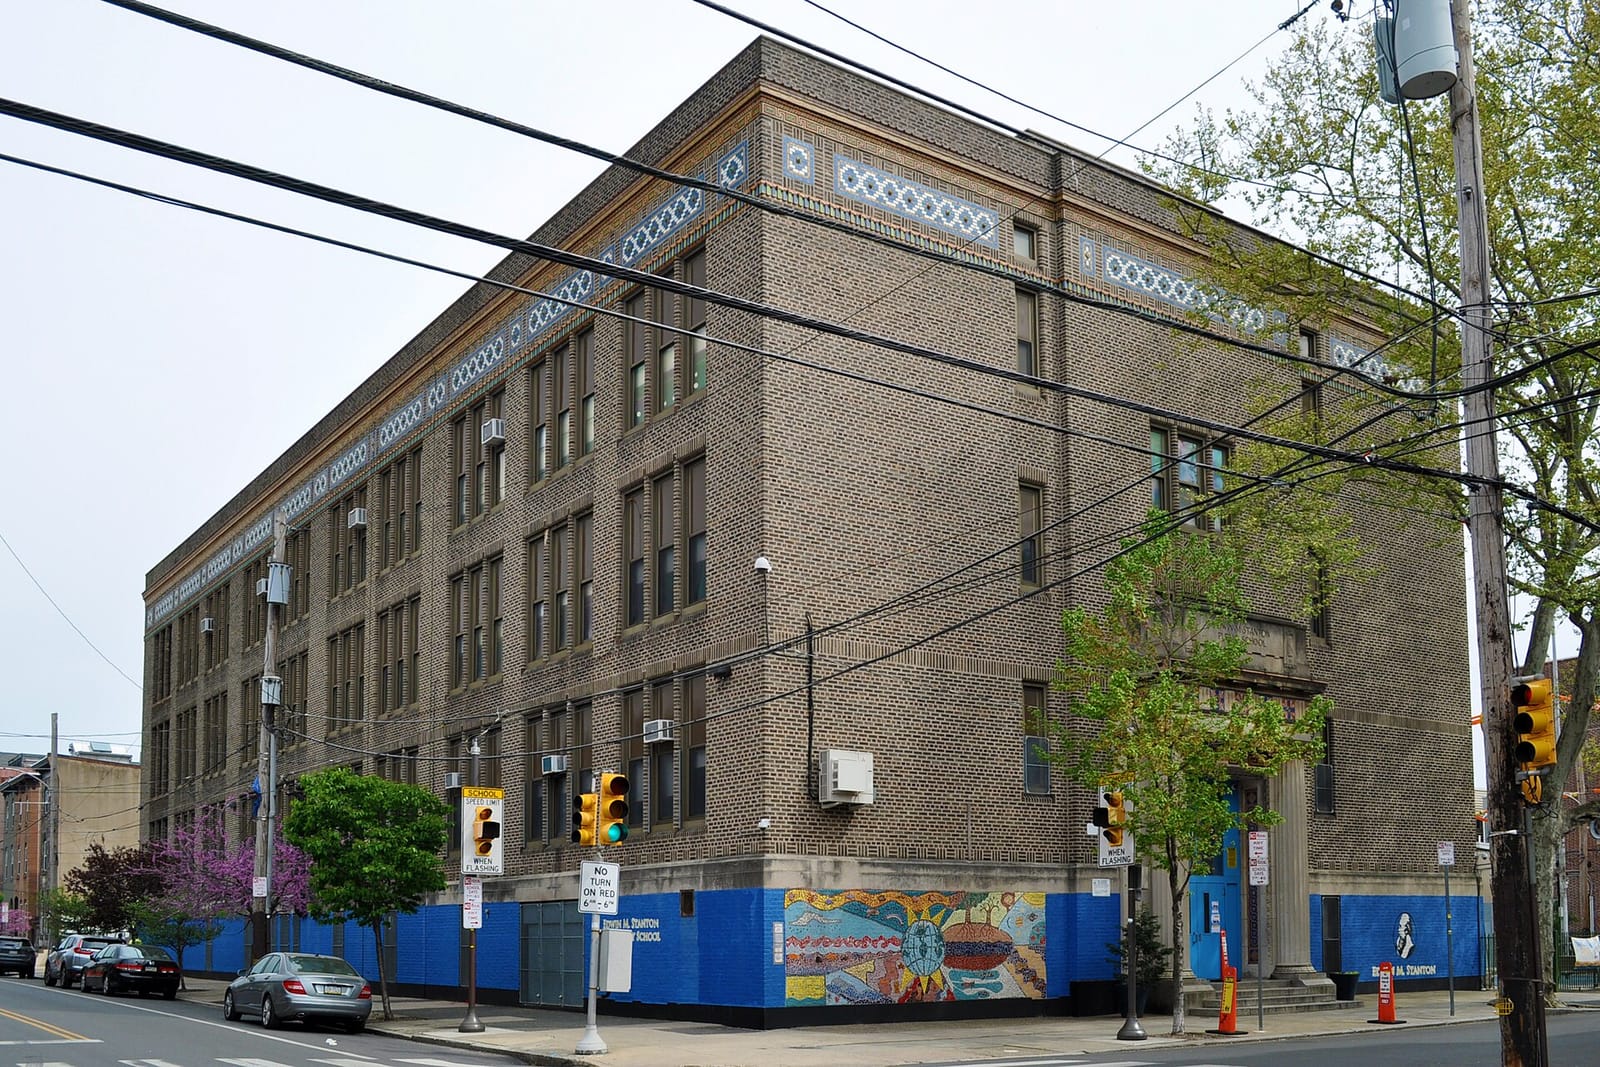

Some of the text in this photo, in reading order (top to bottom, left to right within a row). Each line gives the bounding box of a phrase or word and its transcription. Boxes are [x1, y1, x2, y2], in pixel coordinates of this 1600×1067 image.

[468, 790, 499, 798] SCHOOL
[1108, 848, 1125, 856] WHEN
[473, 857, 493, 865] WHEN
[1102, 856, 1131, 864] FLASHING
[594, 866, 608, 876] NO
[590, 877, 611, 887] TURN
[583, 887, 615, 898] ON RED
[631, 918, 659, 928] STANTON
[636, 931, 661, 941] SCHOOL
[1406, 965, 1436, 975] STANTON
